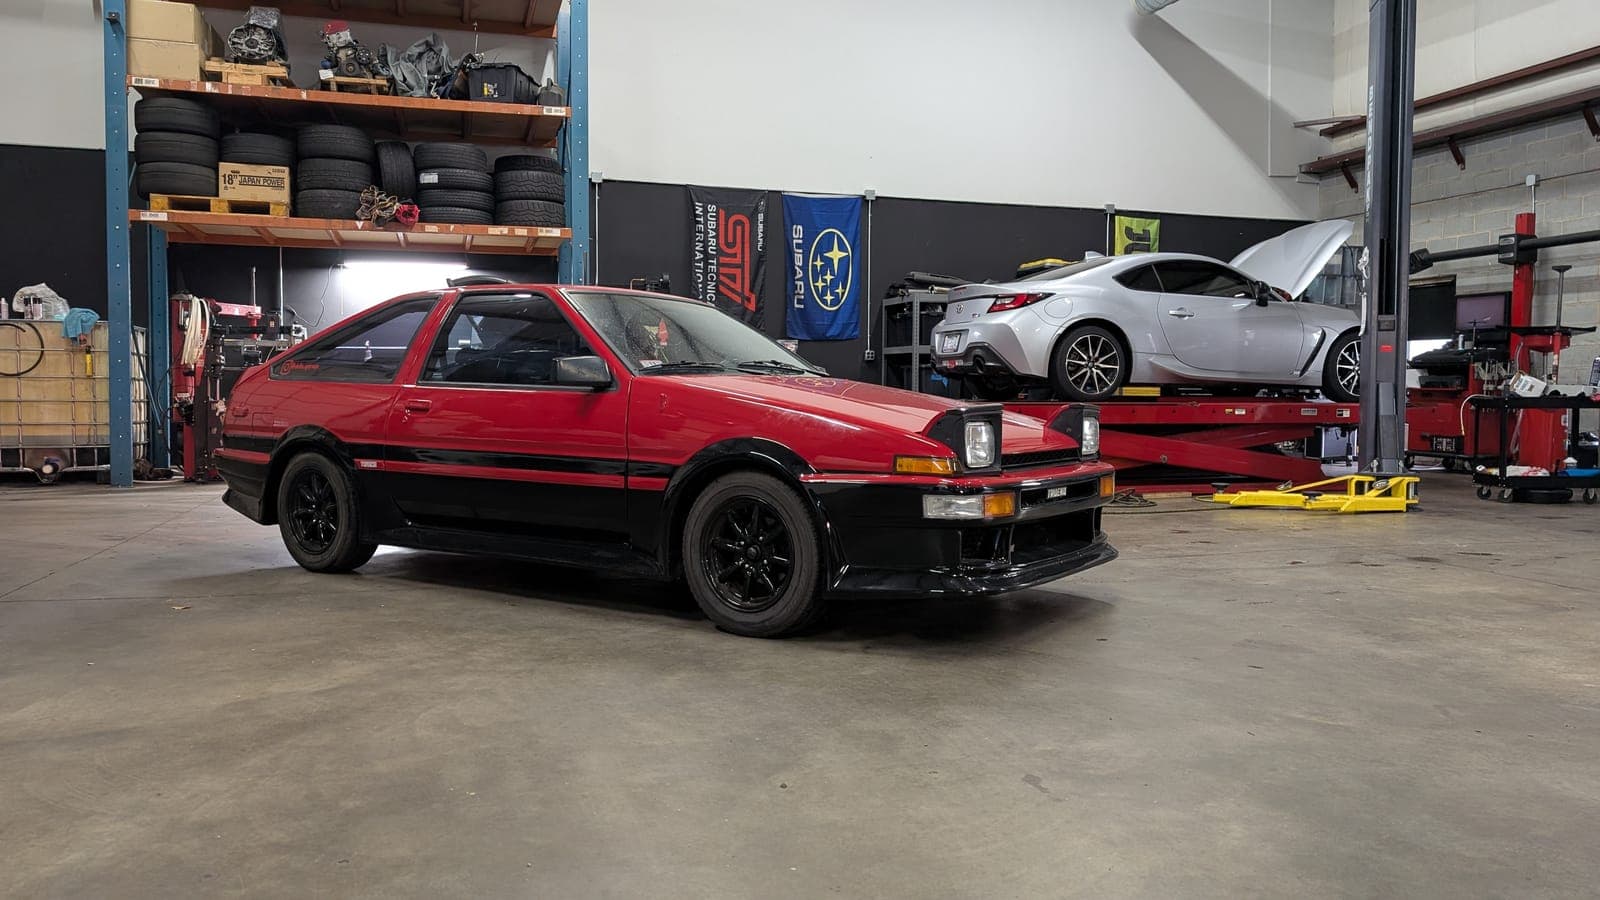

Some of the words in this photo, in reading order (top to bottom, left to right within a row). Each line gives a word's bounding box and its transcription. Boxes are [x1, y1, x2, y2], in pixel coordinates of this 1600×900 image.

[239, 176, 261, 185] JAPAN
[262, 178, 285, 187] POWER
[707, 204, 717, 255] SUBARU
[792, 224, 805, 309] SUBARU
